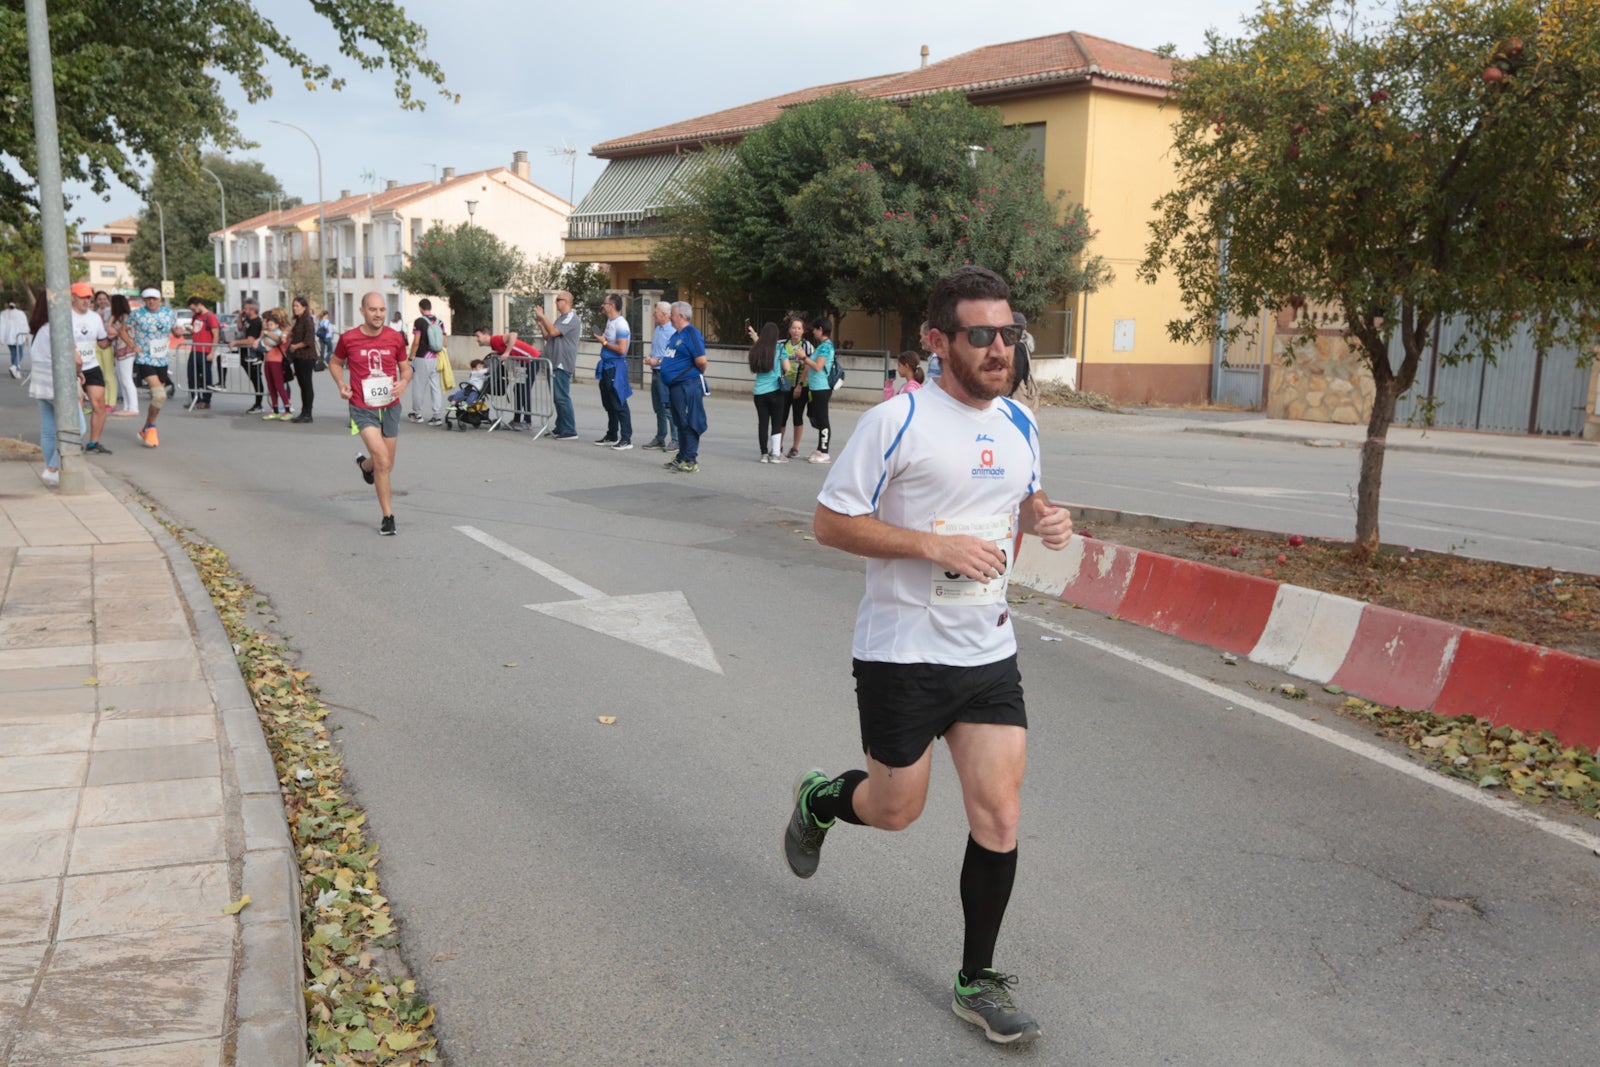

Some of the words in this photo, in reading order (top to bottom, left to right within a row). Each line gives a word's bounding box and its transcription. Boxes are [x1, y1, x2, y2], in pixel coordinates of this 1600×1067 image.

[371, 386, 389, 397] 620
[821, 428, 829, 450] FILA
[971, 467, 1005, 476] animade
